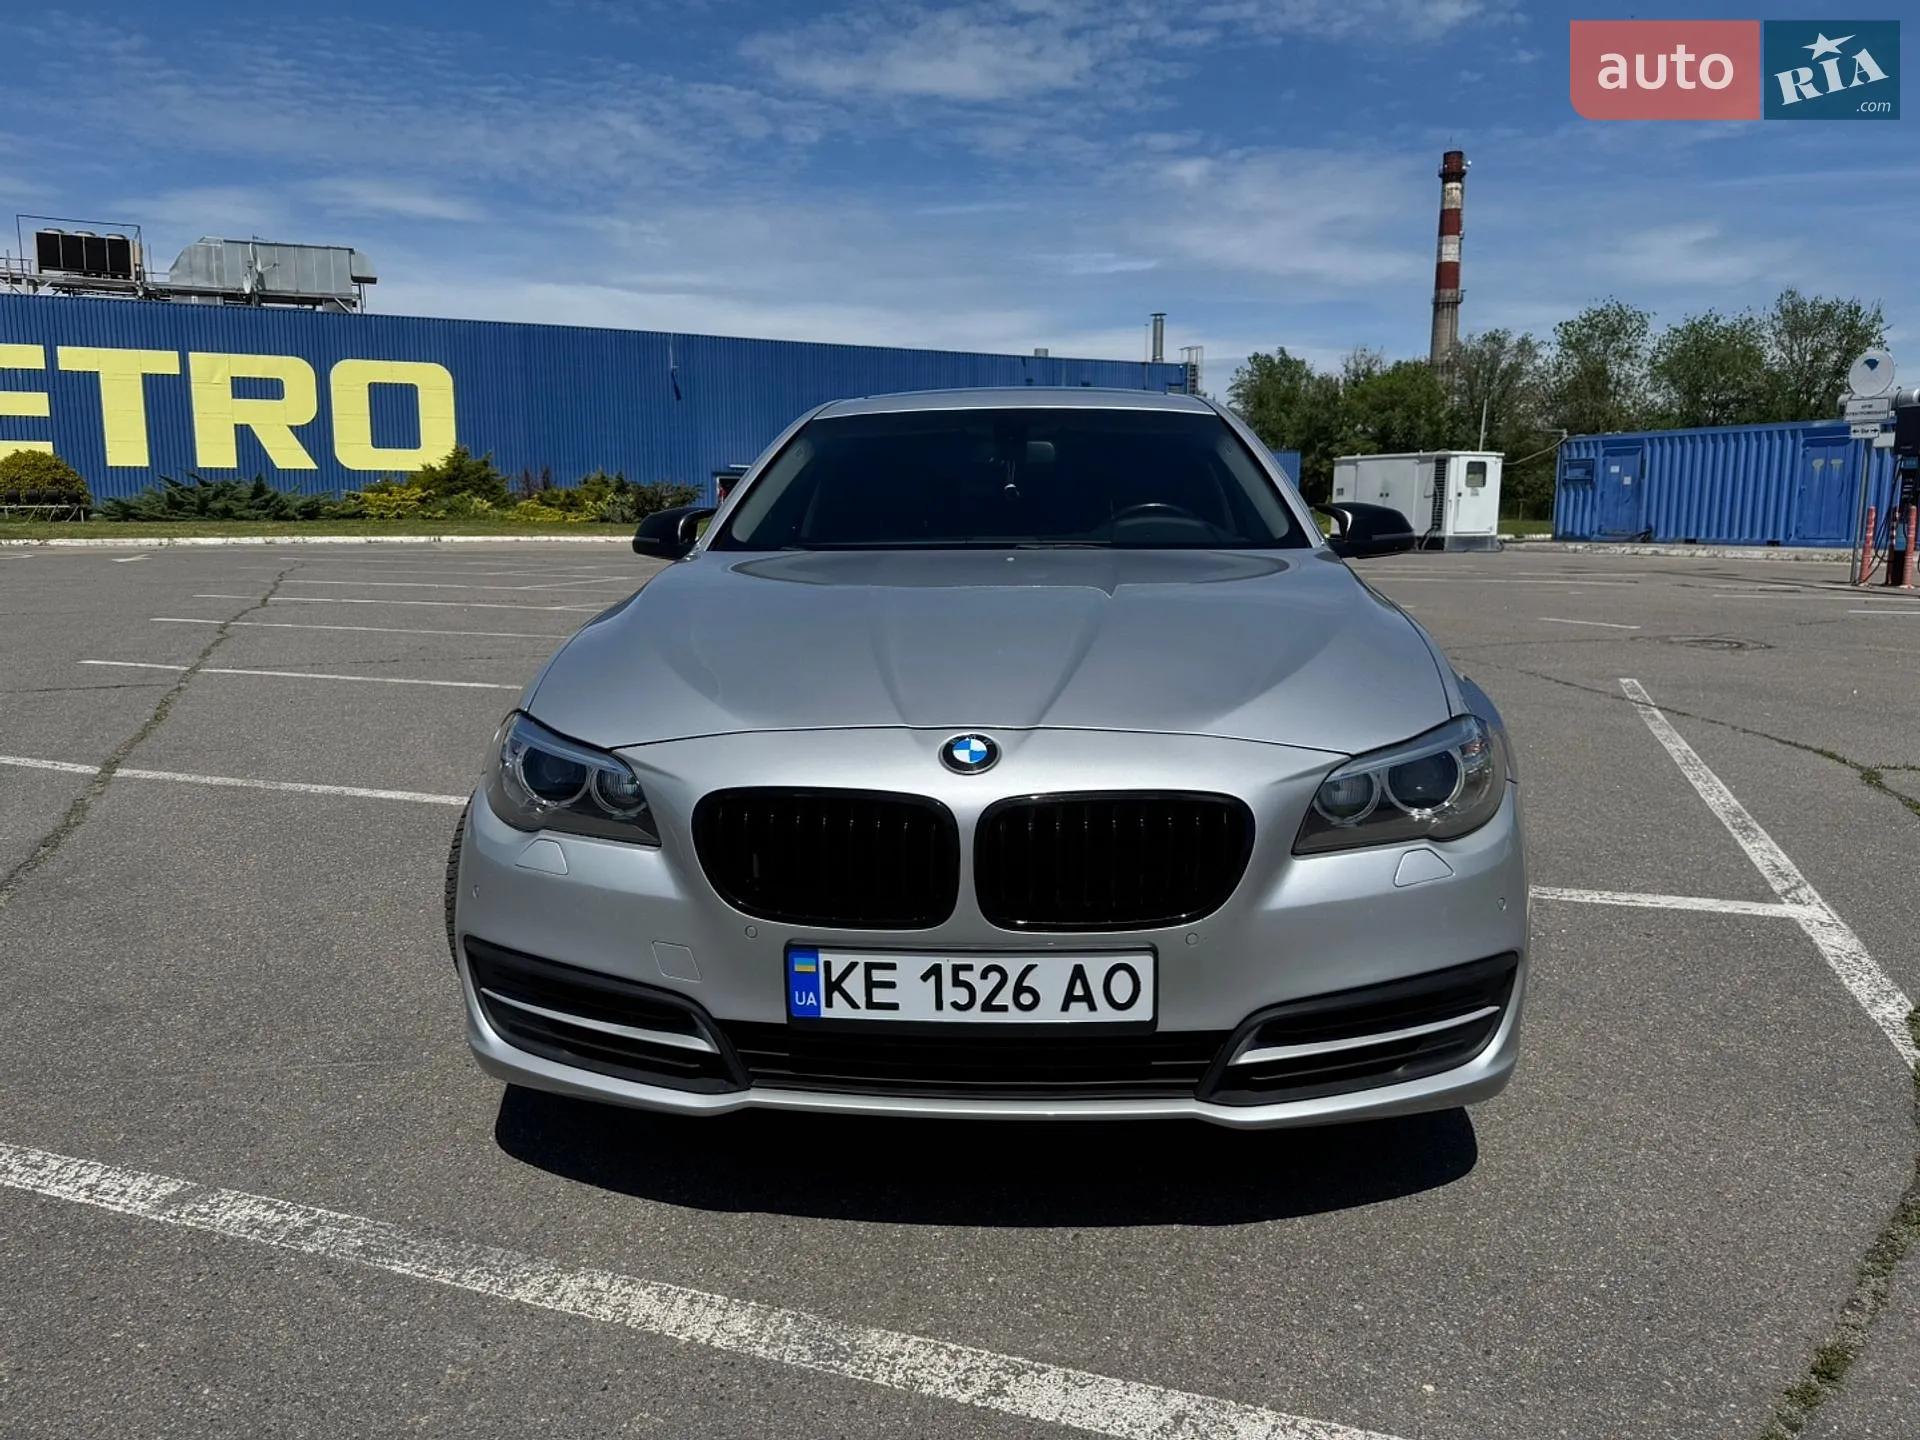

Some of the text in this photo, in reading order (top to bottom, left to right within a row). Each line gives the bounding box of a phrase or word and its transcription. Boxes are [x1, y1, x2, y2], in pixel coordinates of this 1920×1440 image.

[794, 991, 818, 1006] UA
[822, 960, 1142, 1013] KE 1526 AO
